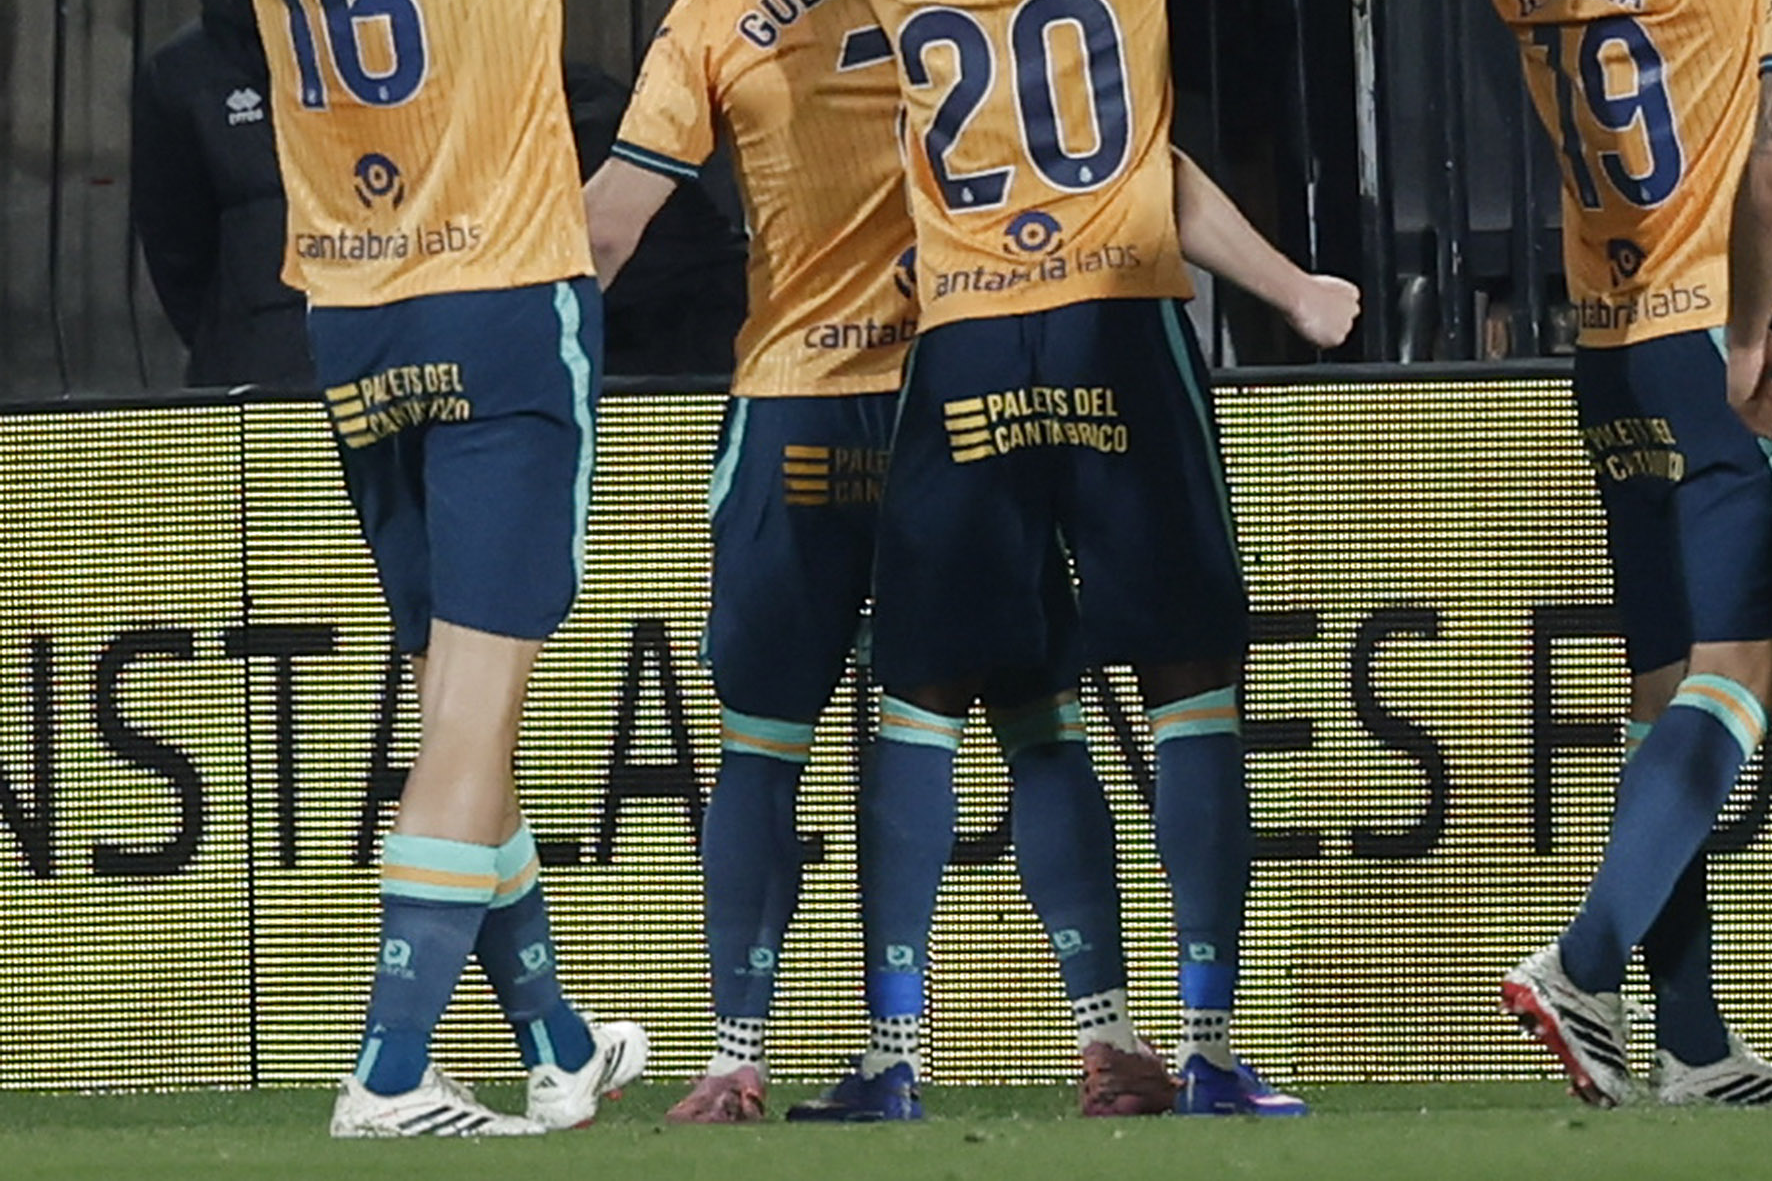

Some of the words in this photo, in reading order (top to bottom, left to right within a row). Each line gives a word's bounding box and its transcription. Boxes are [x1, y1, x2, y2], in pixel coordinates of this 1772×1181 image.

[1520, 13, 1685, 210] 19
[416, 220, 483, 256] labs
[1643, 284, 1712, 321] labs
[423, 362, 464, 393] DEL
[986, 386, 1070, 423] PALETS
[1073, 387, 1118, 418] DEL
[994, 419, 1128, 455] CANTABRICO
